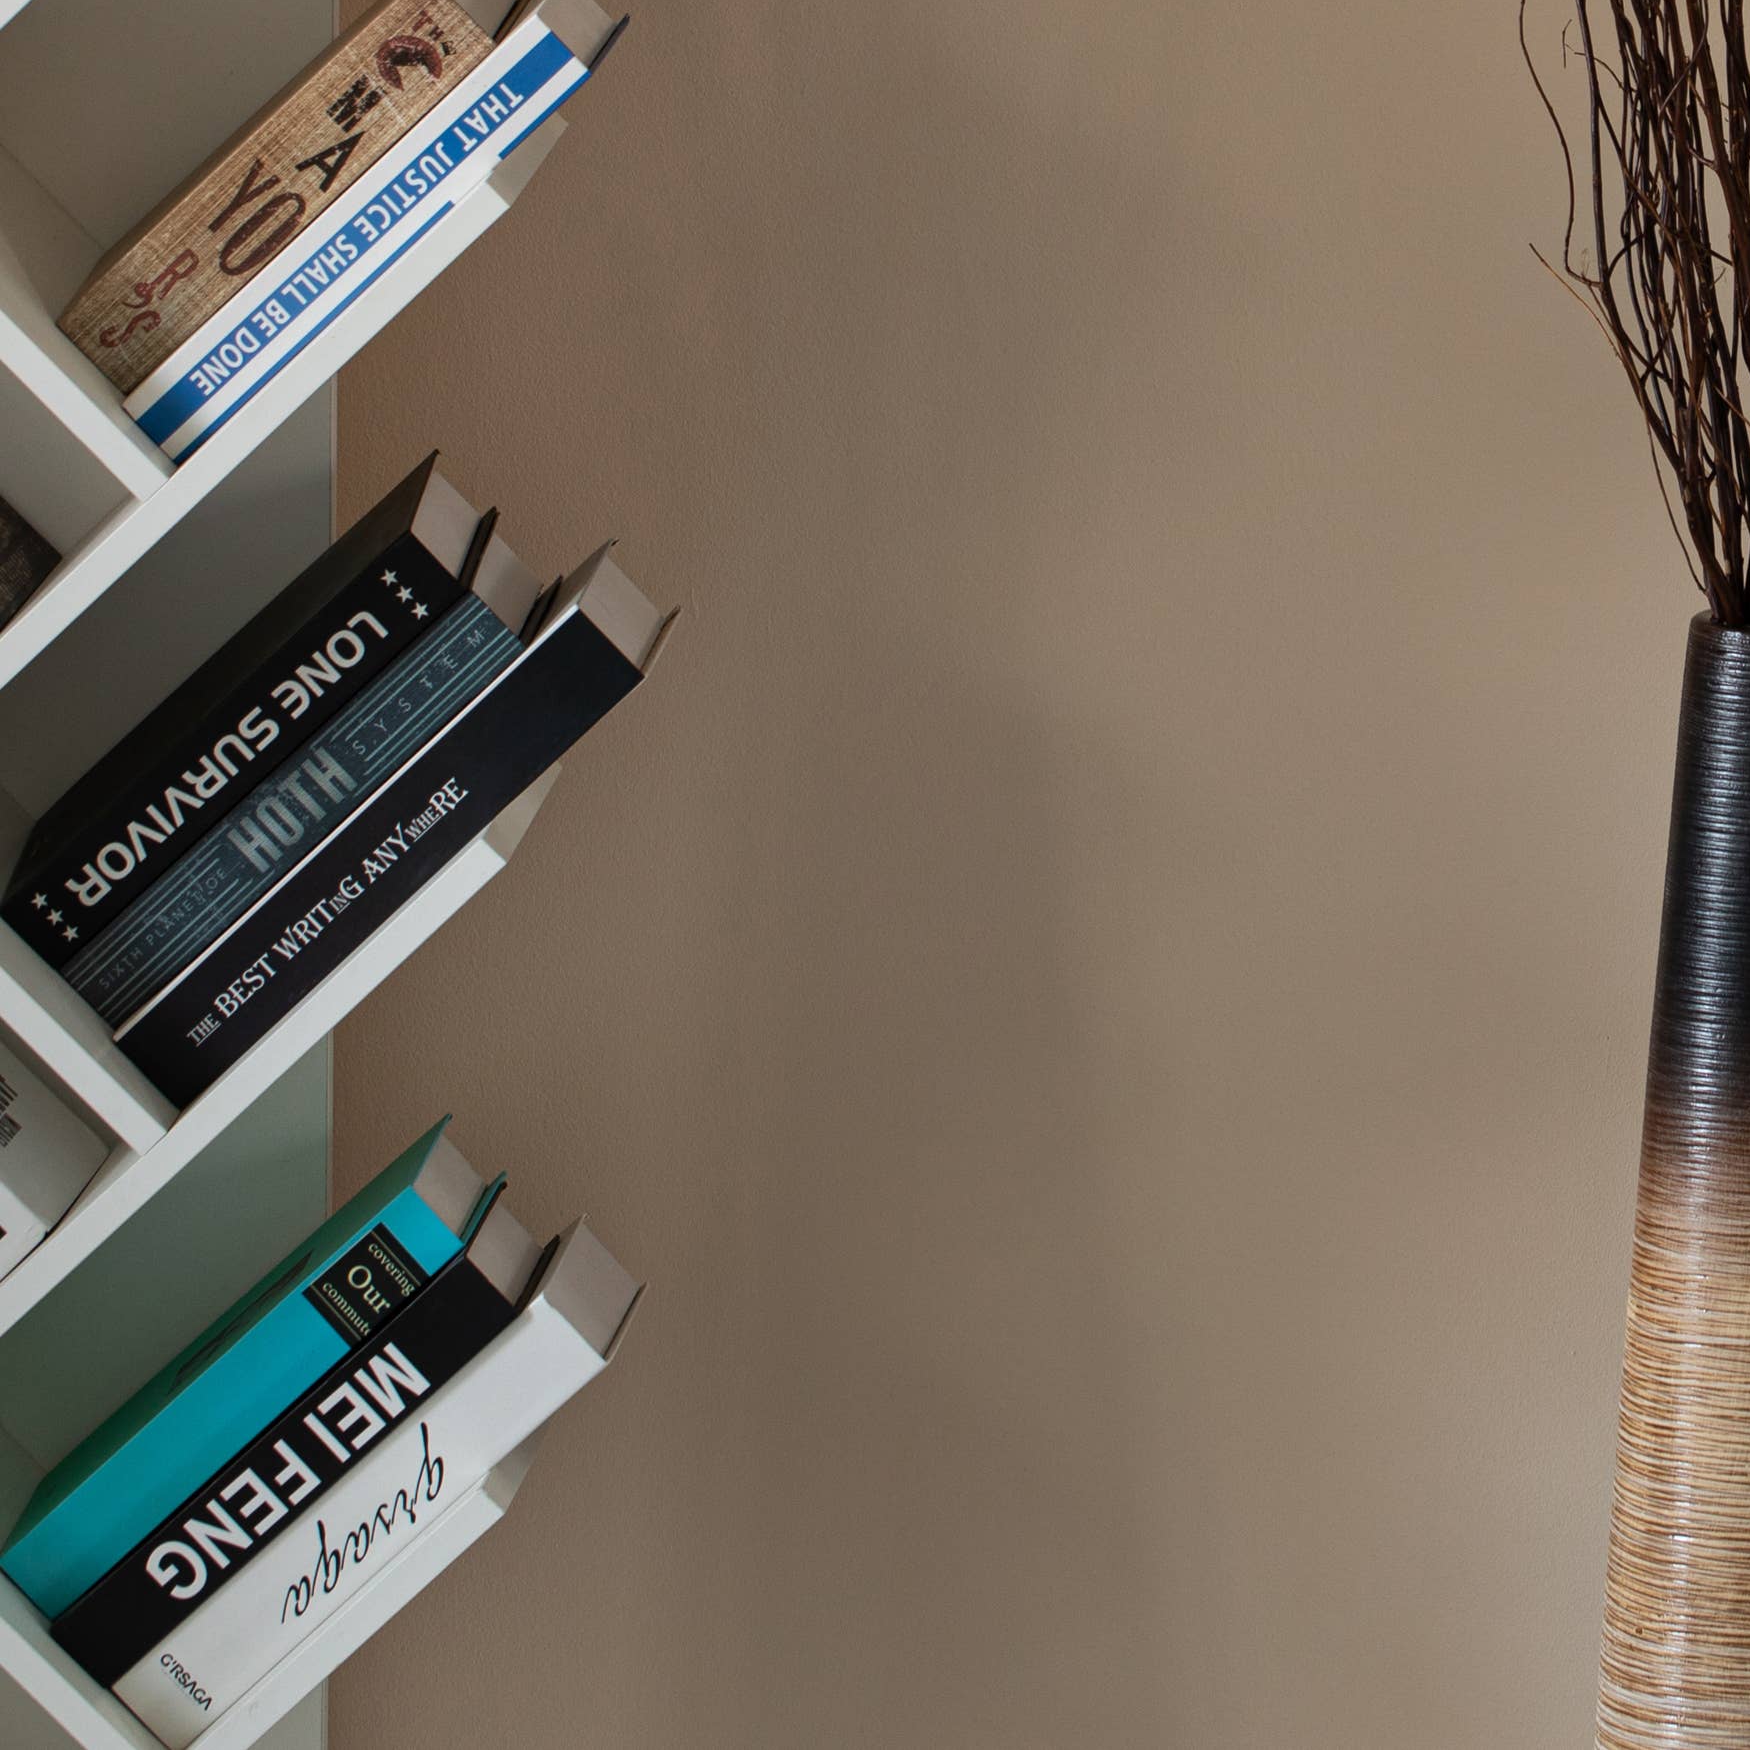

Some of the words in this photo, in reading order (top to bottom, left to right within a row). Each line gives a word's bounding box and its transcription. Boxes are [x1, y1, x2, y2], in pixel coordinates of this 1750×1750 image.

[453, 83, 524, 152] THAT
[353, 142, 454, 242] JUSTICE
[281, 234, 359, 305] SHALL
[189, 327, 261, 397] DONE
[252, 298, 291, 338] BE
[271, 611, 389, 720] LONE
[352, 628, 486, 755] SYSTEM
[65, 706, 280, 907] SURVIVOR
[227, 747, 358, 873] HOTH
[99, 949, 144, 988] SIXTH
[186, 1013, 222, 1048] THE
[213, 953, 276, 1018] BEST
[348, 1265, 391, 1314] Our
[368, 1243, 415, 1297] covering
[303, 1342, 431, 1464] MEI
[145, 1438, 322, 1599] FENG
